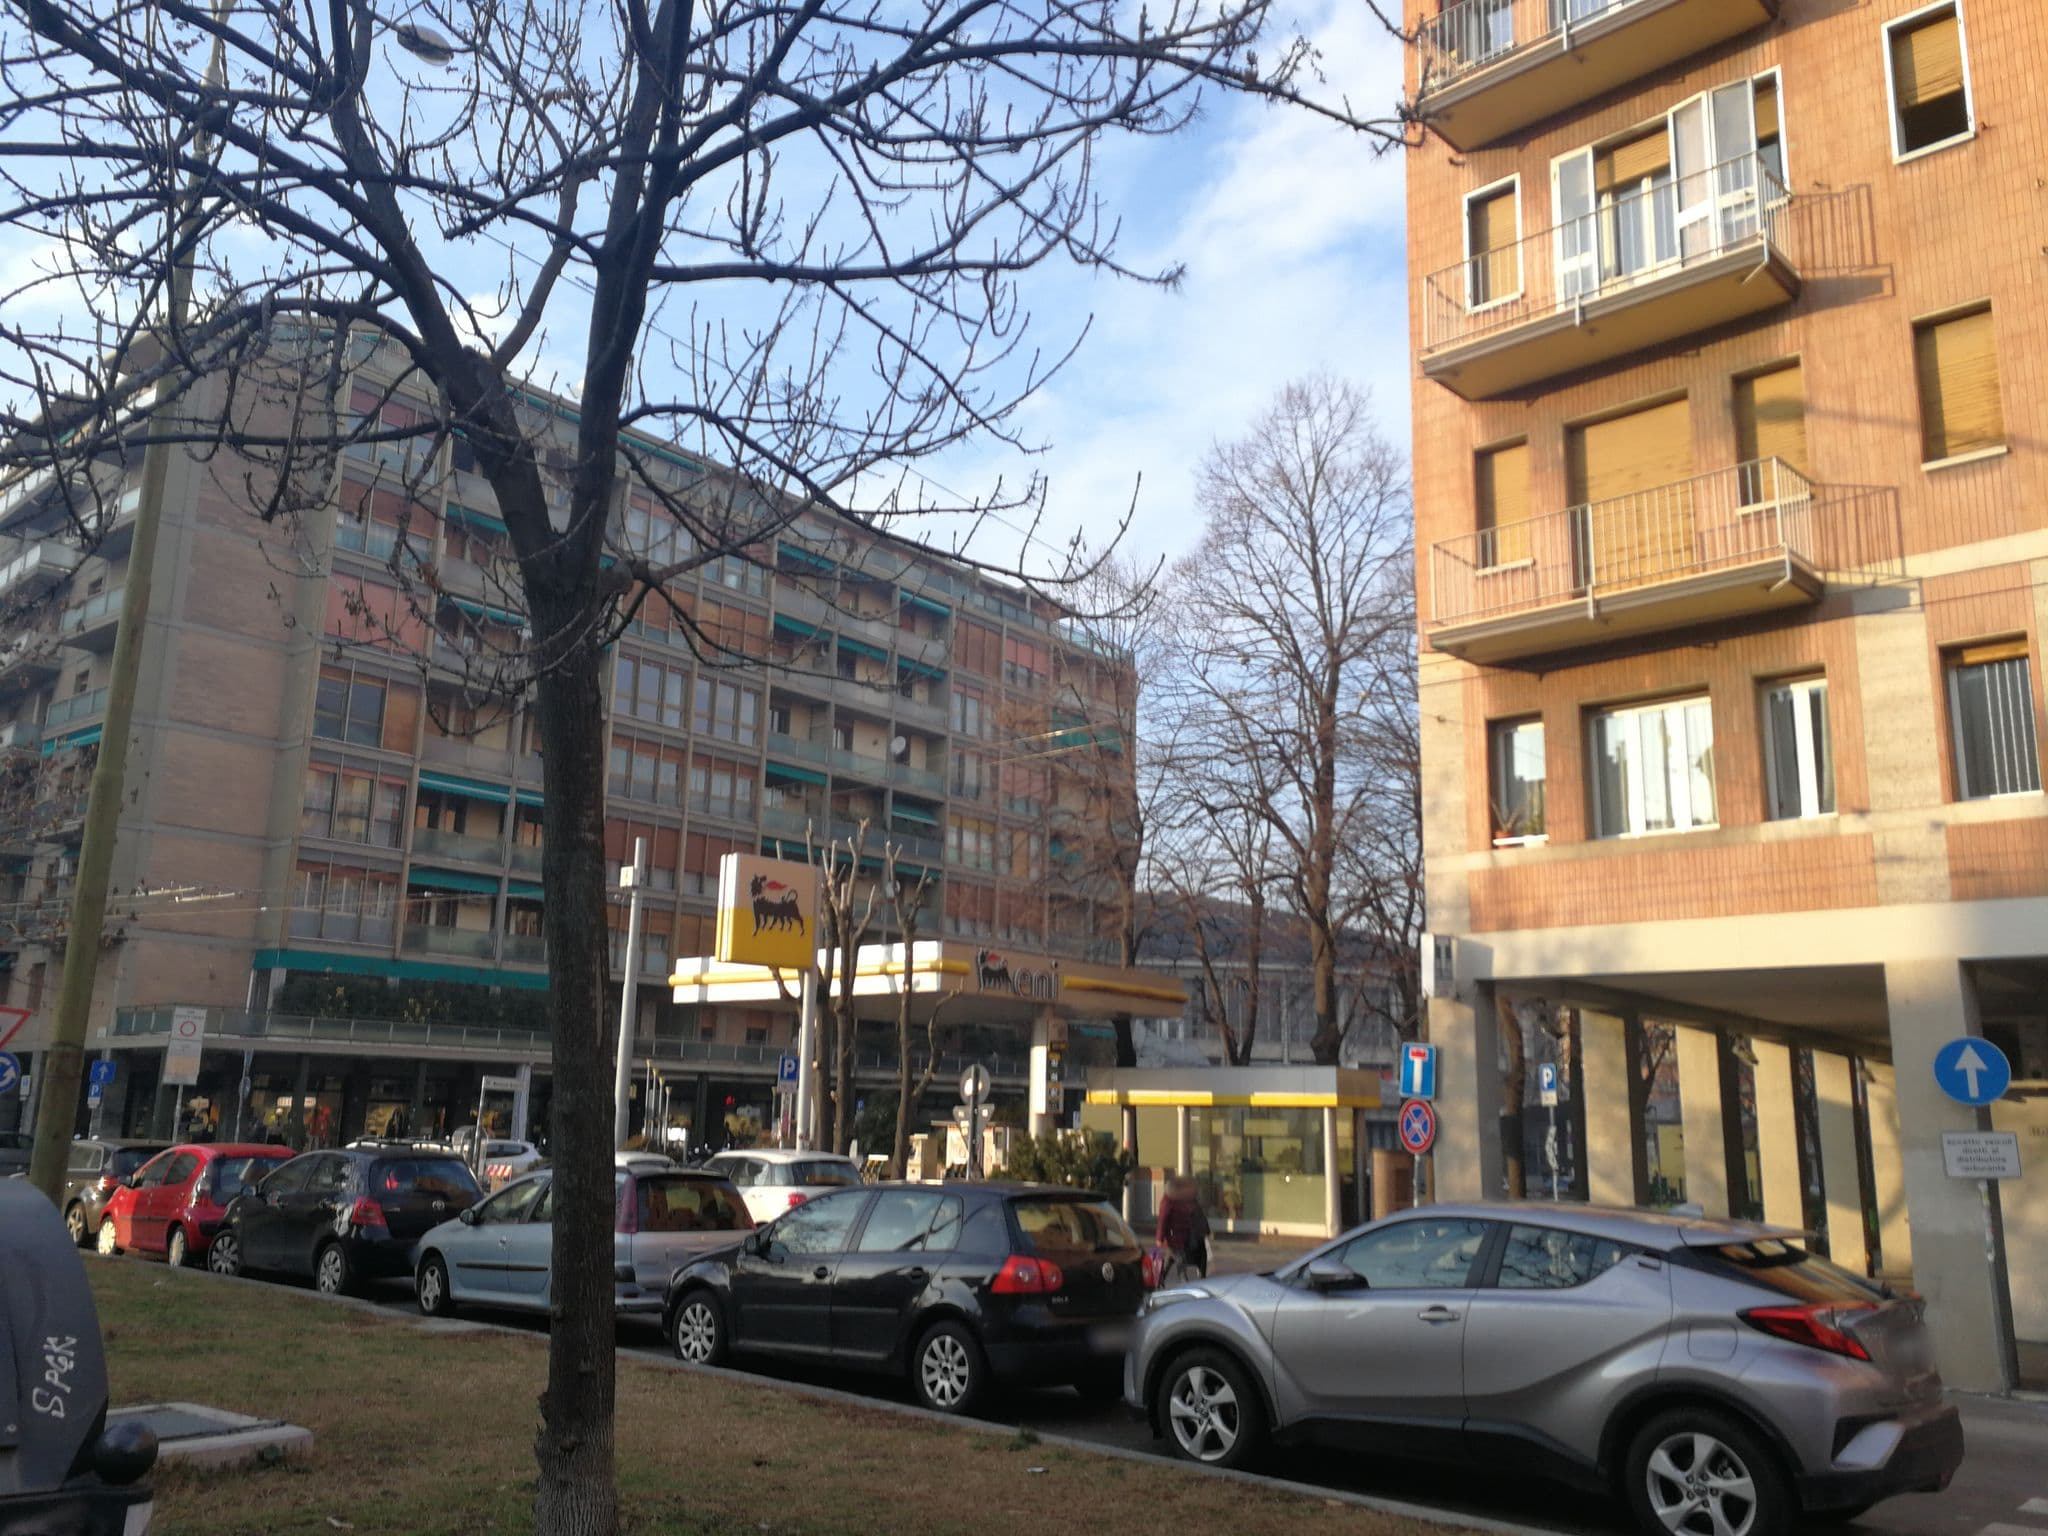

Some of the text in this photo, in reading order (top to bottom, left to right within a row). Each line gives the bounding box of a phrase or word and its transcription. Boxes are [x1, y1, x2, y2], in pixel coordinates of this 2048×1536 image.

[1014, 960, 1058, 1000] eni
[783, 1059, 795, 1079] P
[1543, 1066, 1553, 1089] P
[91, 1084, 99, 1096] P
